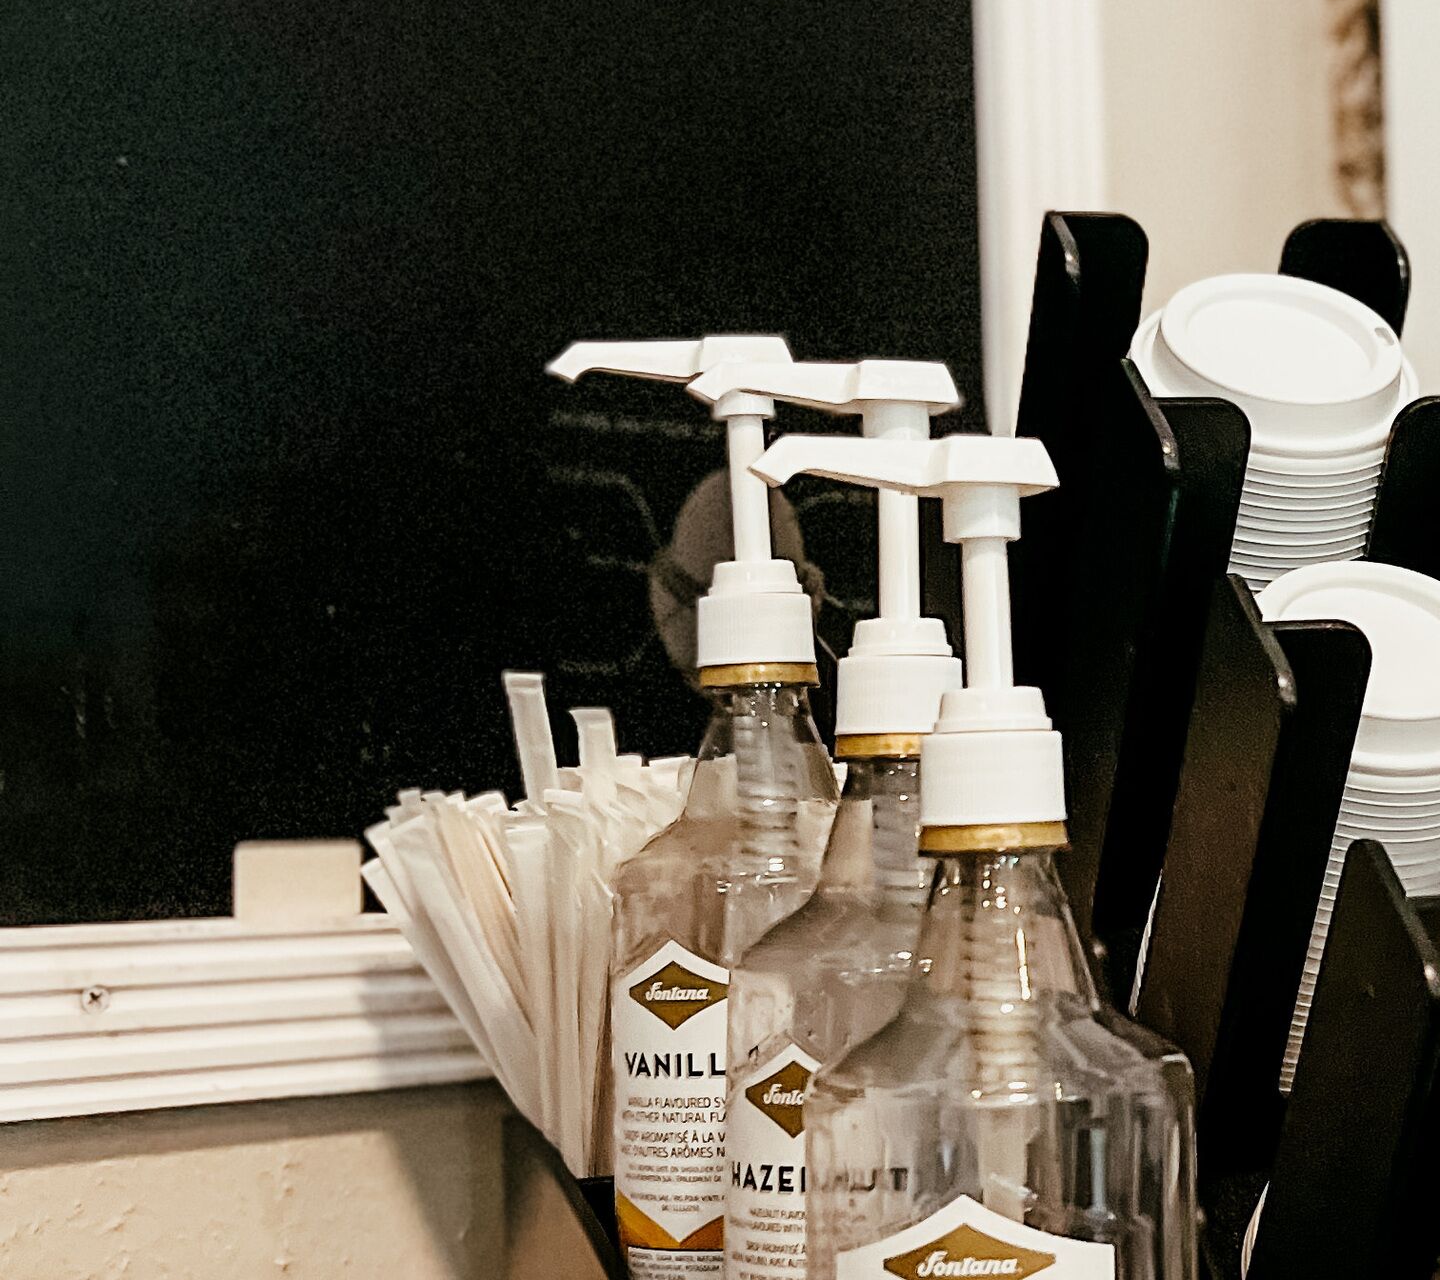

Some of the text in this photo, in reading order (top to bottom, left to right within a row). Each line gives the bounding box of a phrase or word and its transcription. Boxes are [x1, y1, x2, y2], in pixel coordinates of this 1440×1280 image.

[645, 981, 710, 1001] Fontana
[624, 1051, 727, 1079] VANILL
[916, 1250, 1018, 1278] Fontana
